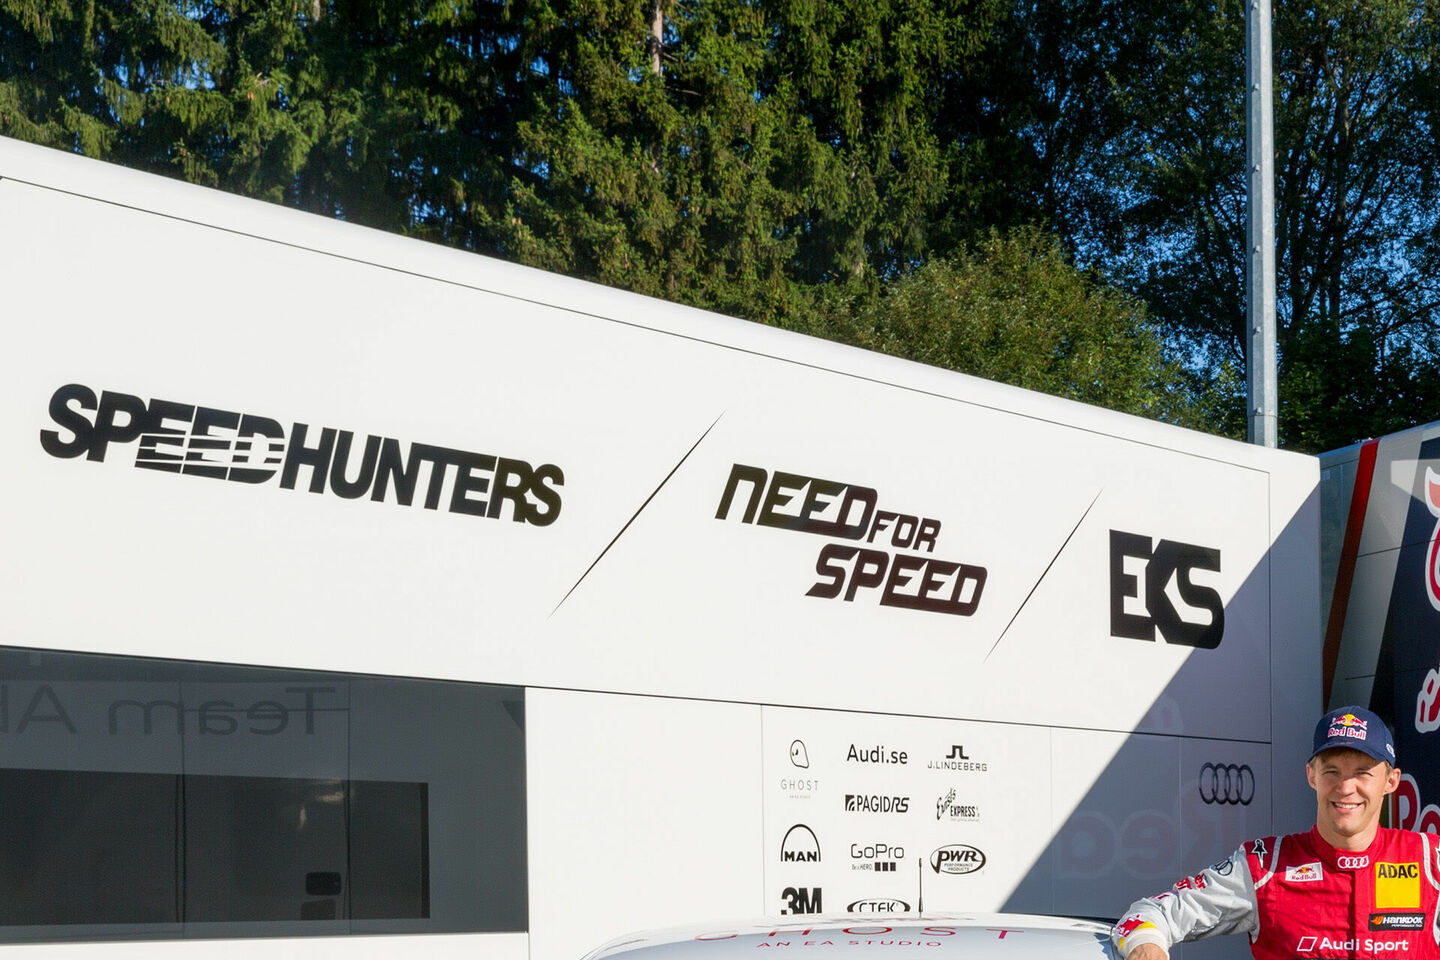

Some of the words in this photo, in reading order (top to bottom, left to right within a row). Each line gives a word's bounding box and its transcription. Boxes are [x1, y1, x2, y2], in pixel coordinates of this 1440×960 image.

[40, 383, 565, 527] SPEEDHUNTERS
[714, 463, 878, 540] NEED
[867, 510, 942, 552] FOR
[805, 543, 988, 617] SPEED
[1109, 529, 1225, 650] EKS
[1328, 726, 1346, 738] Red
[1346, 728, 1366, 741] Bull
[847, 744, 908, 765] Audi.se
[928, 761, 988, 772] J.LINDEBERG
[780, 779, 819, 791] GHOST
[950, 805, 976, 818] EXPRESS
[784, 851, 818, 862] MAN
[850, 843, 905, 859] GoPro
[1378, 864, 1418, 878] ADAC
[781, 887, 823, 915] 3M
[1319, 937, 1360, 951] Audi
[1364, 938, 1409, 954] Sport
